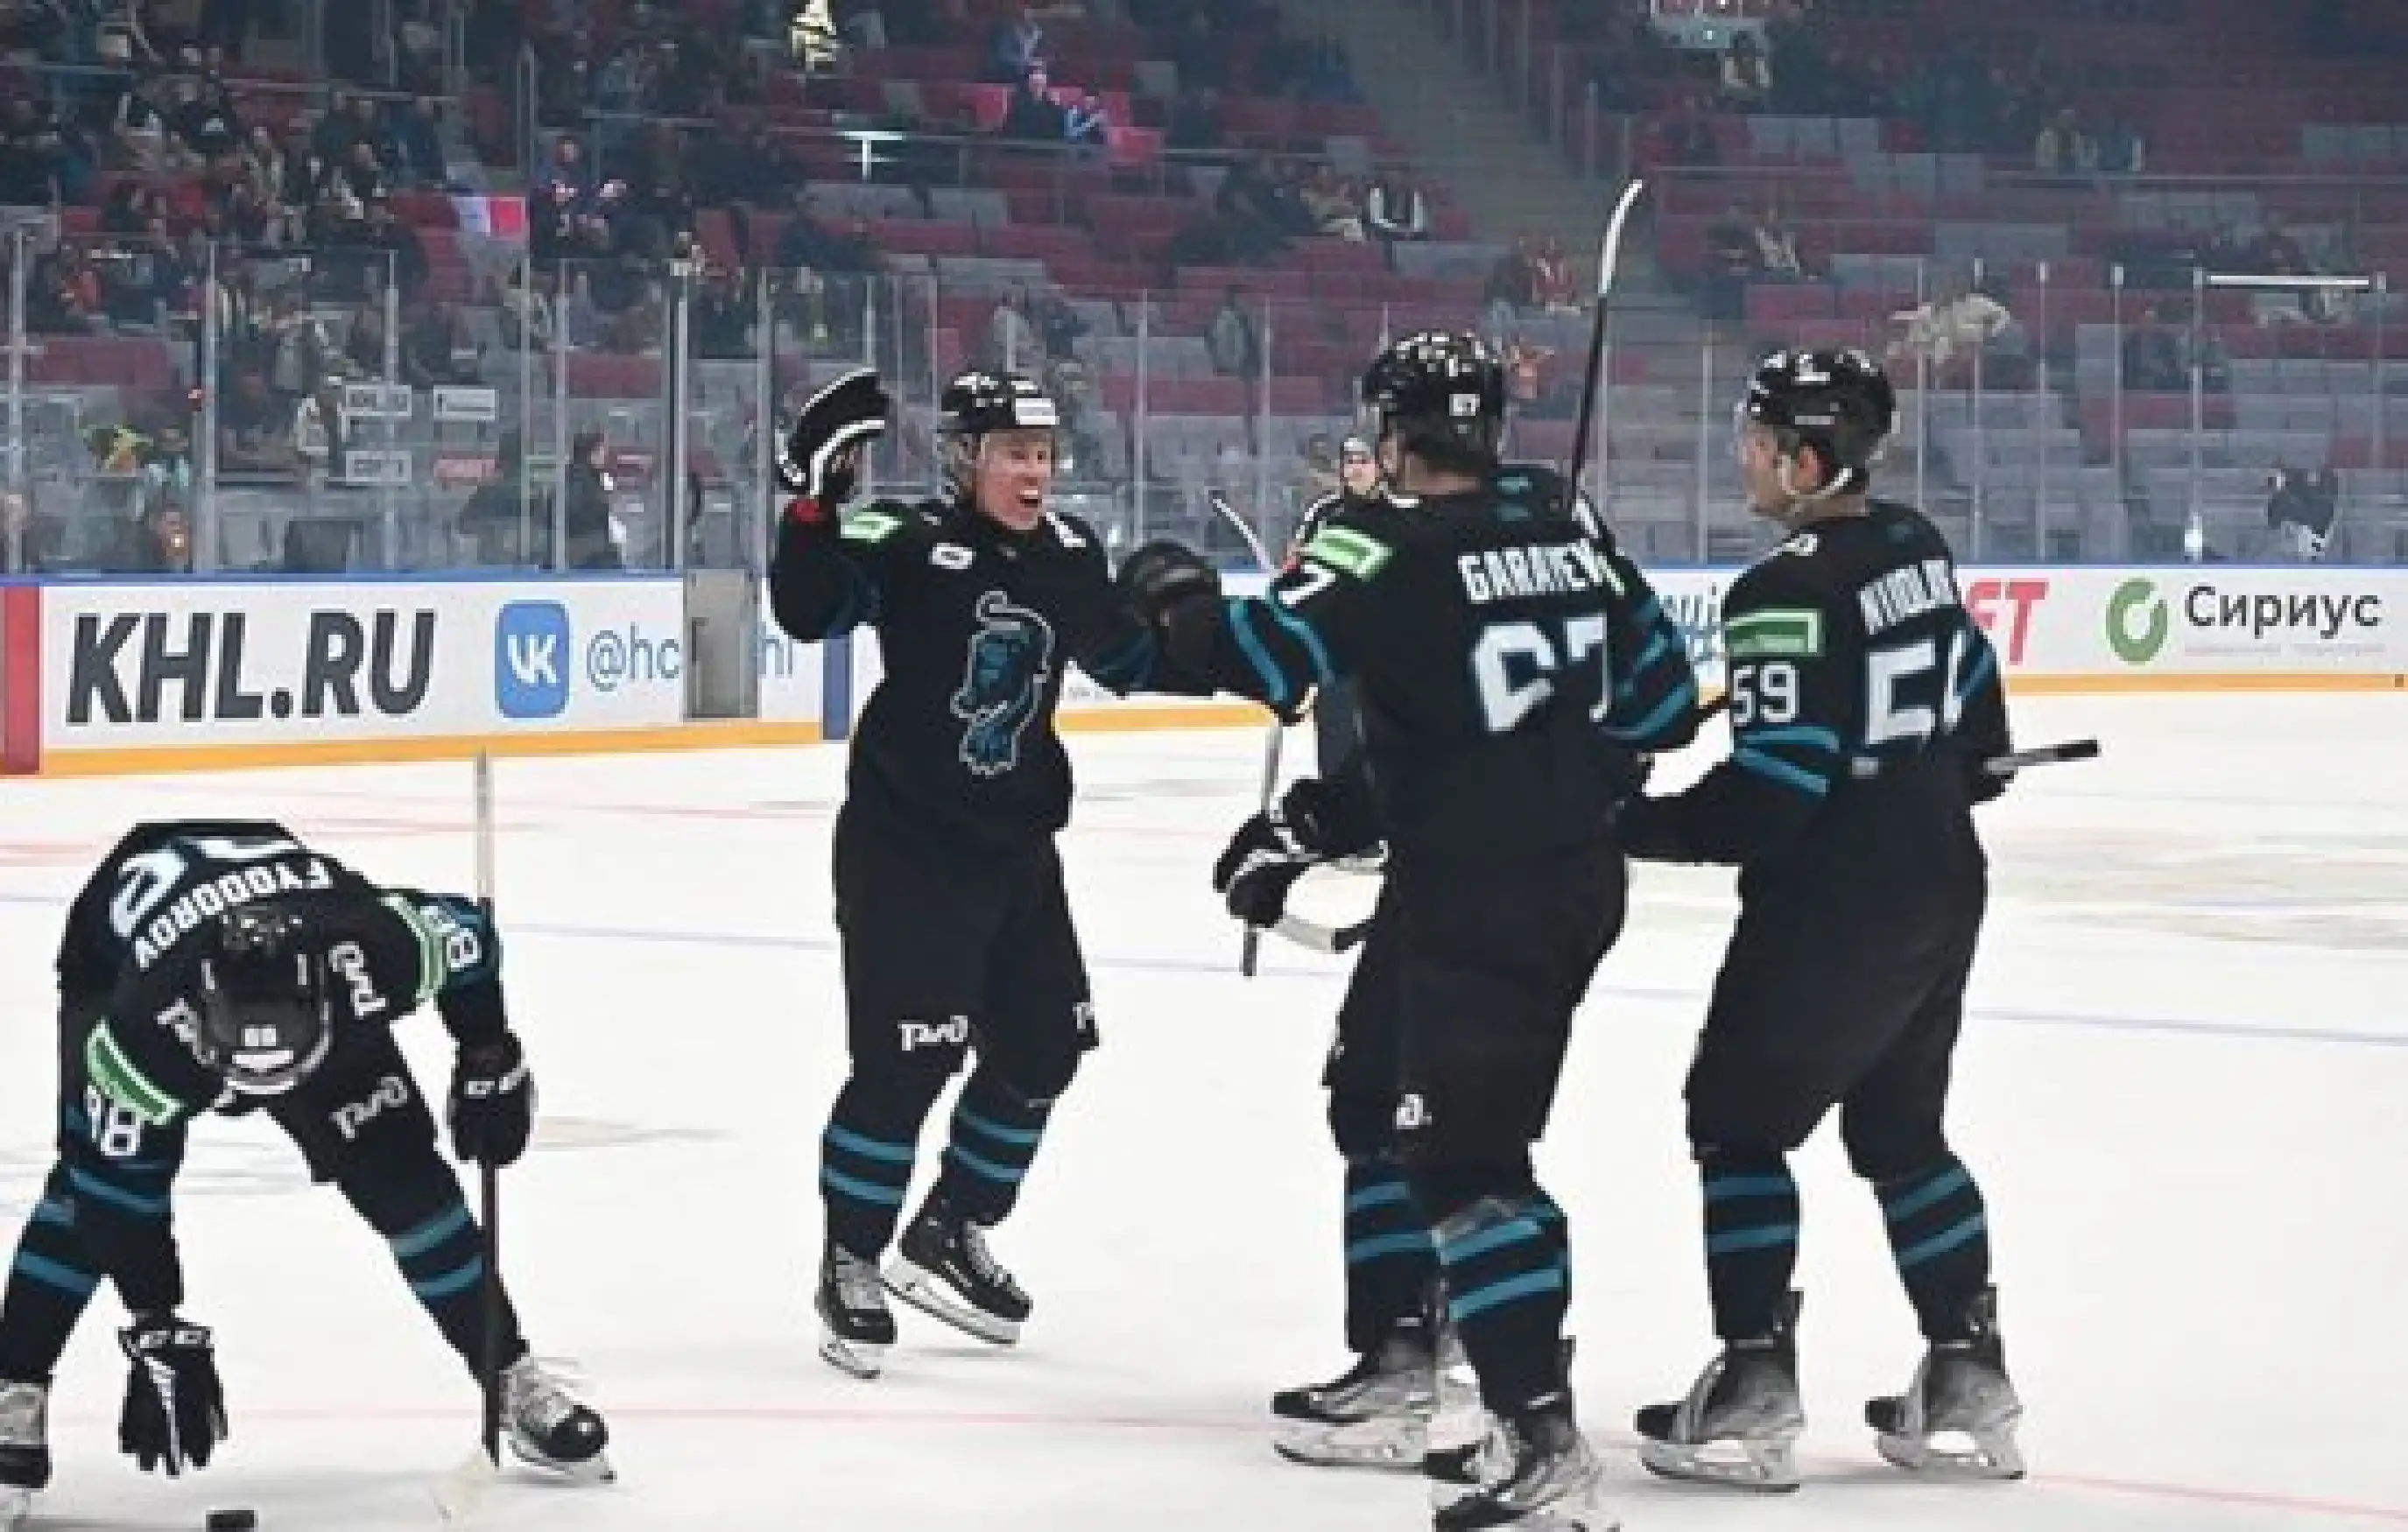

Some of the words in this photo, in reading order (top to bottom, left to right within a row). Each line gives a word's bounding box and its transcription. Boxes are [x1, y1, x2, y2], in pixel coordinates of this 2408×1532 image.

[2183, 584, 2383, 640] Сириус
[66, 608, 436, 725] KHL.RU
[1731, 661, 1800, 725] 59
